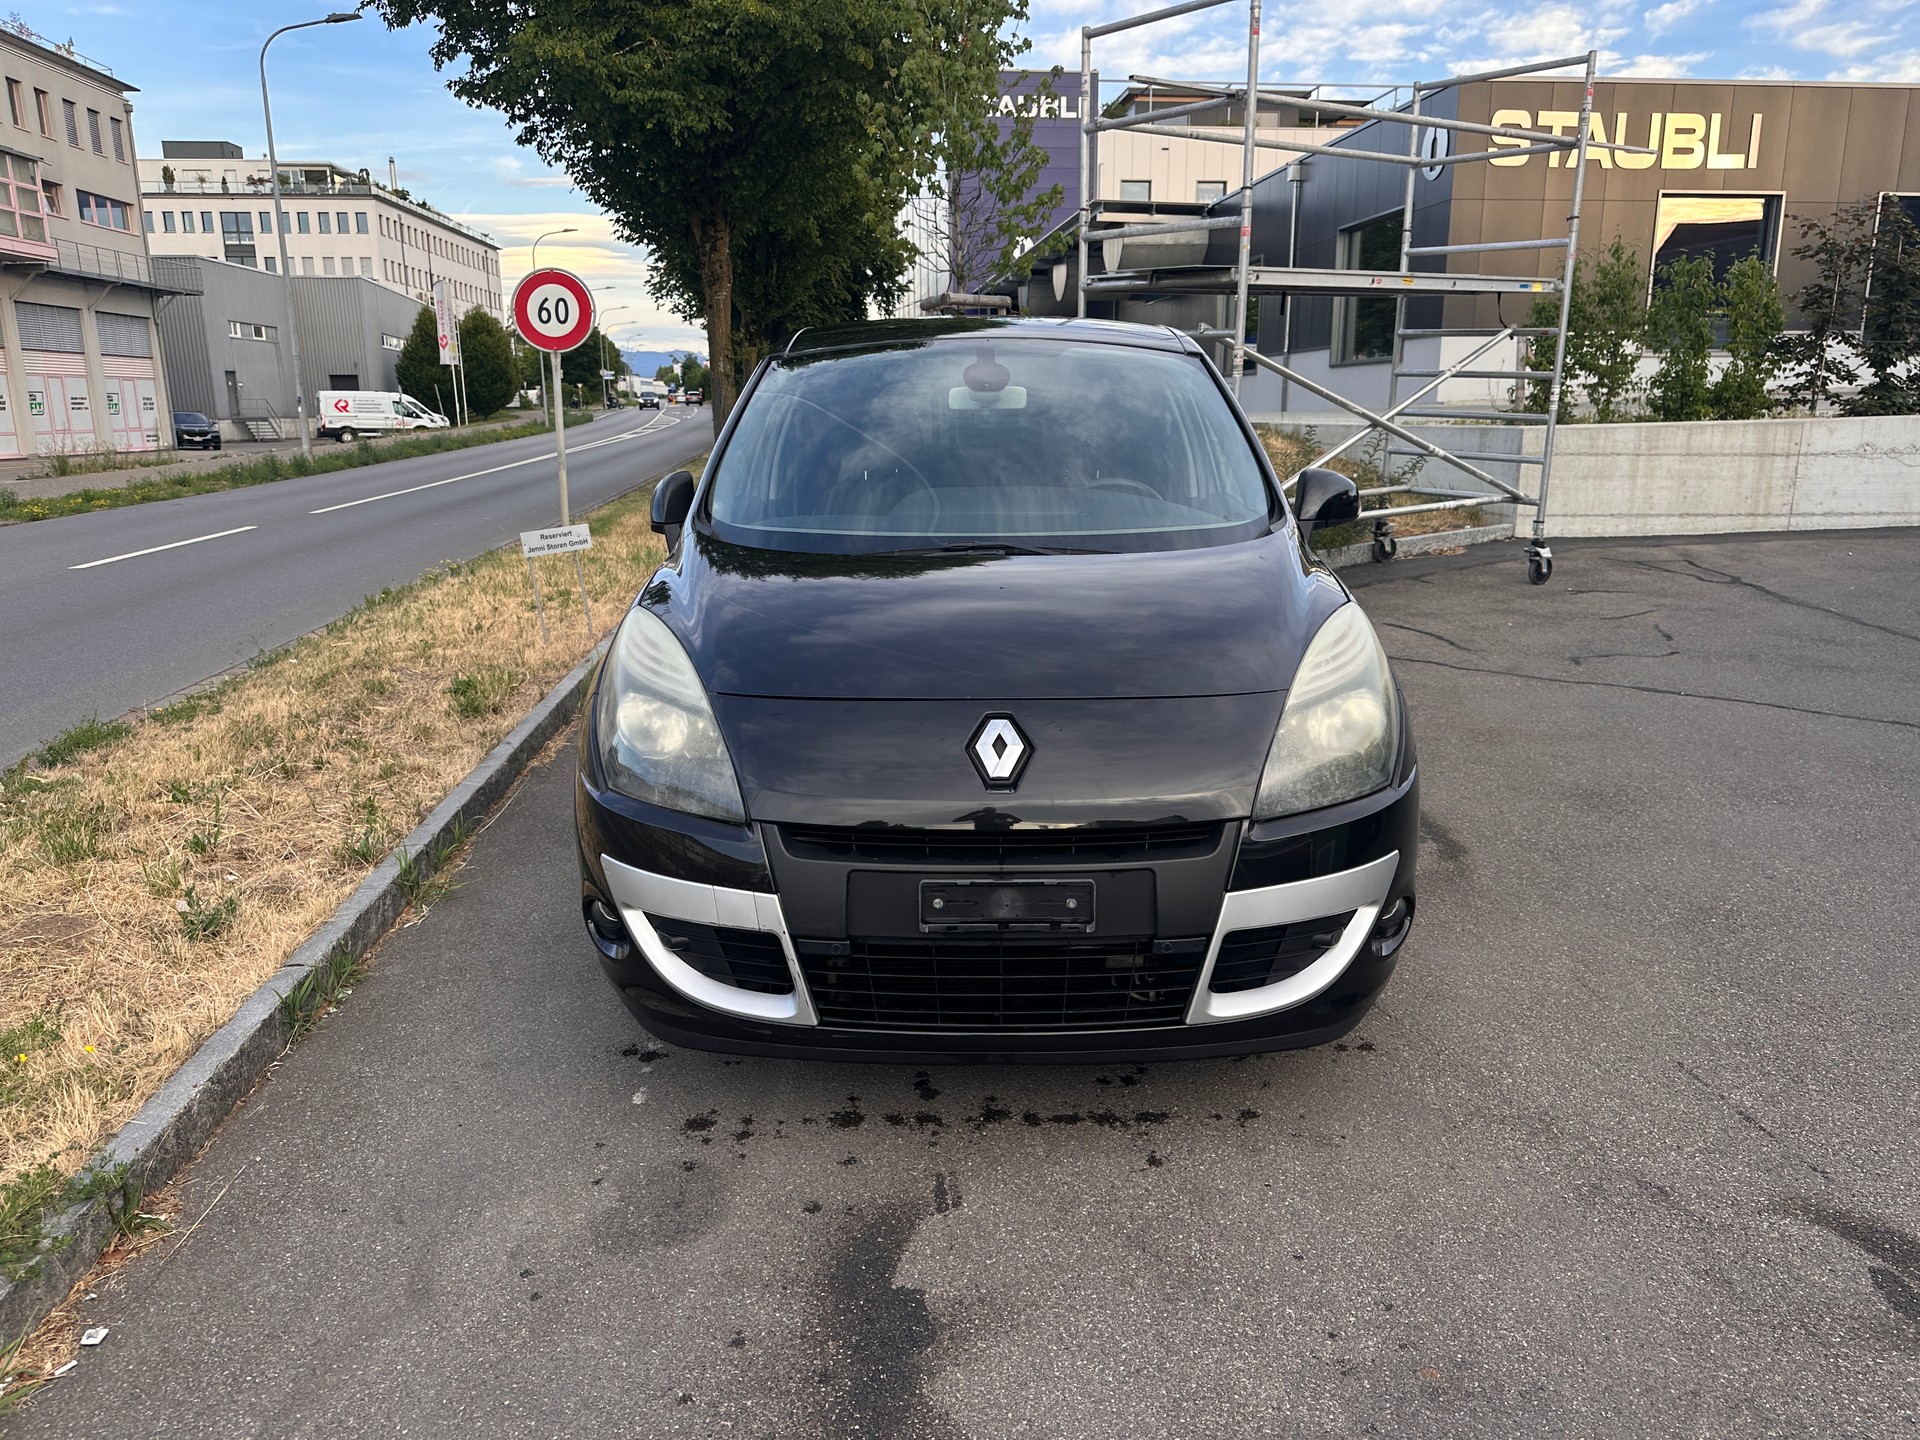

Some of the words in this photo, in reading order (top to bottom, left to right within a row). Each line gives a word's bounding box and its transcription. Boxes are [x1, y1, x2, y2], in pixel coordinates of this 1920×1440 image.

[1487, 109, 1763, 170] STAUBLI
[537, 296, 570, 325] 60
[527, 545, 546, 554] Jenni
[546, 541, 568, 551] Storen
[568, 538, 589, 547] GmbH
[539, 530, 573, 541] Reserviert
